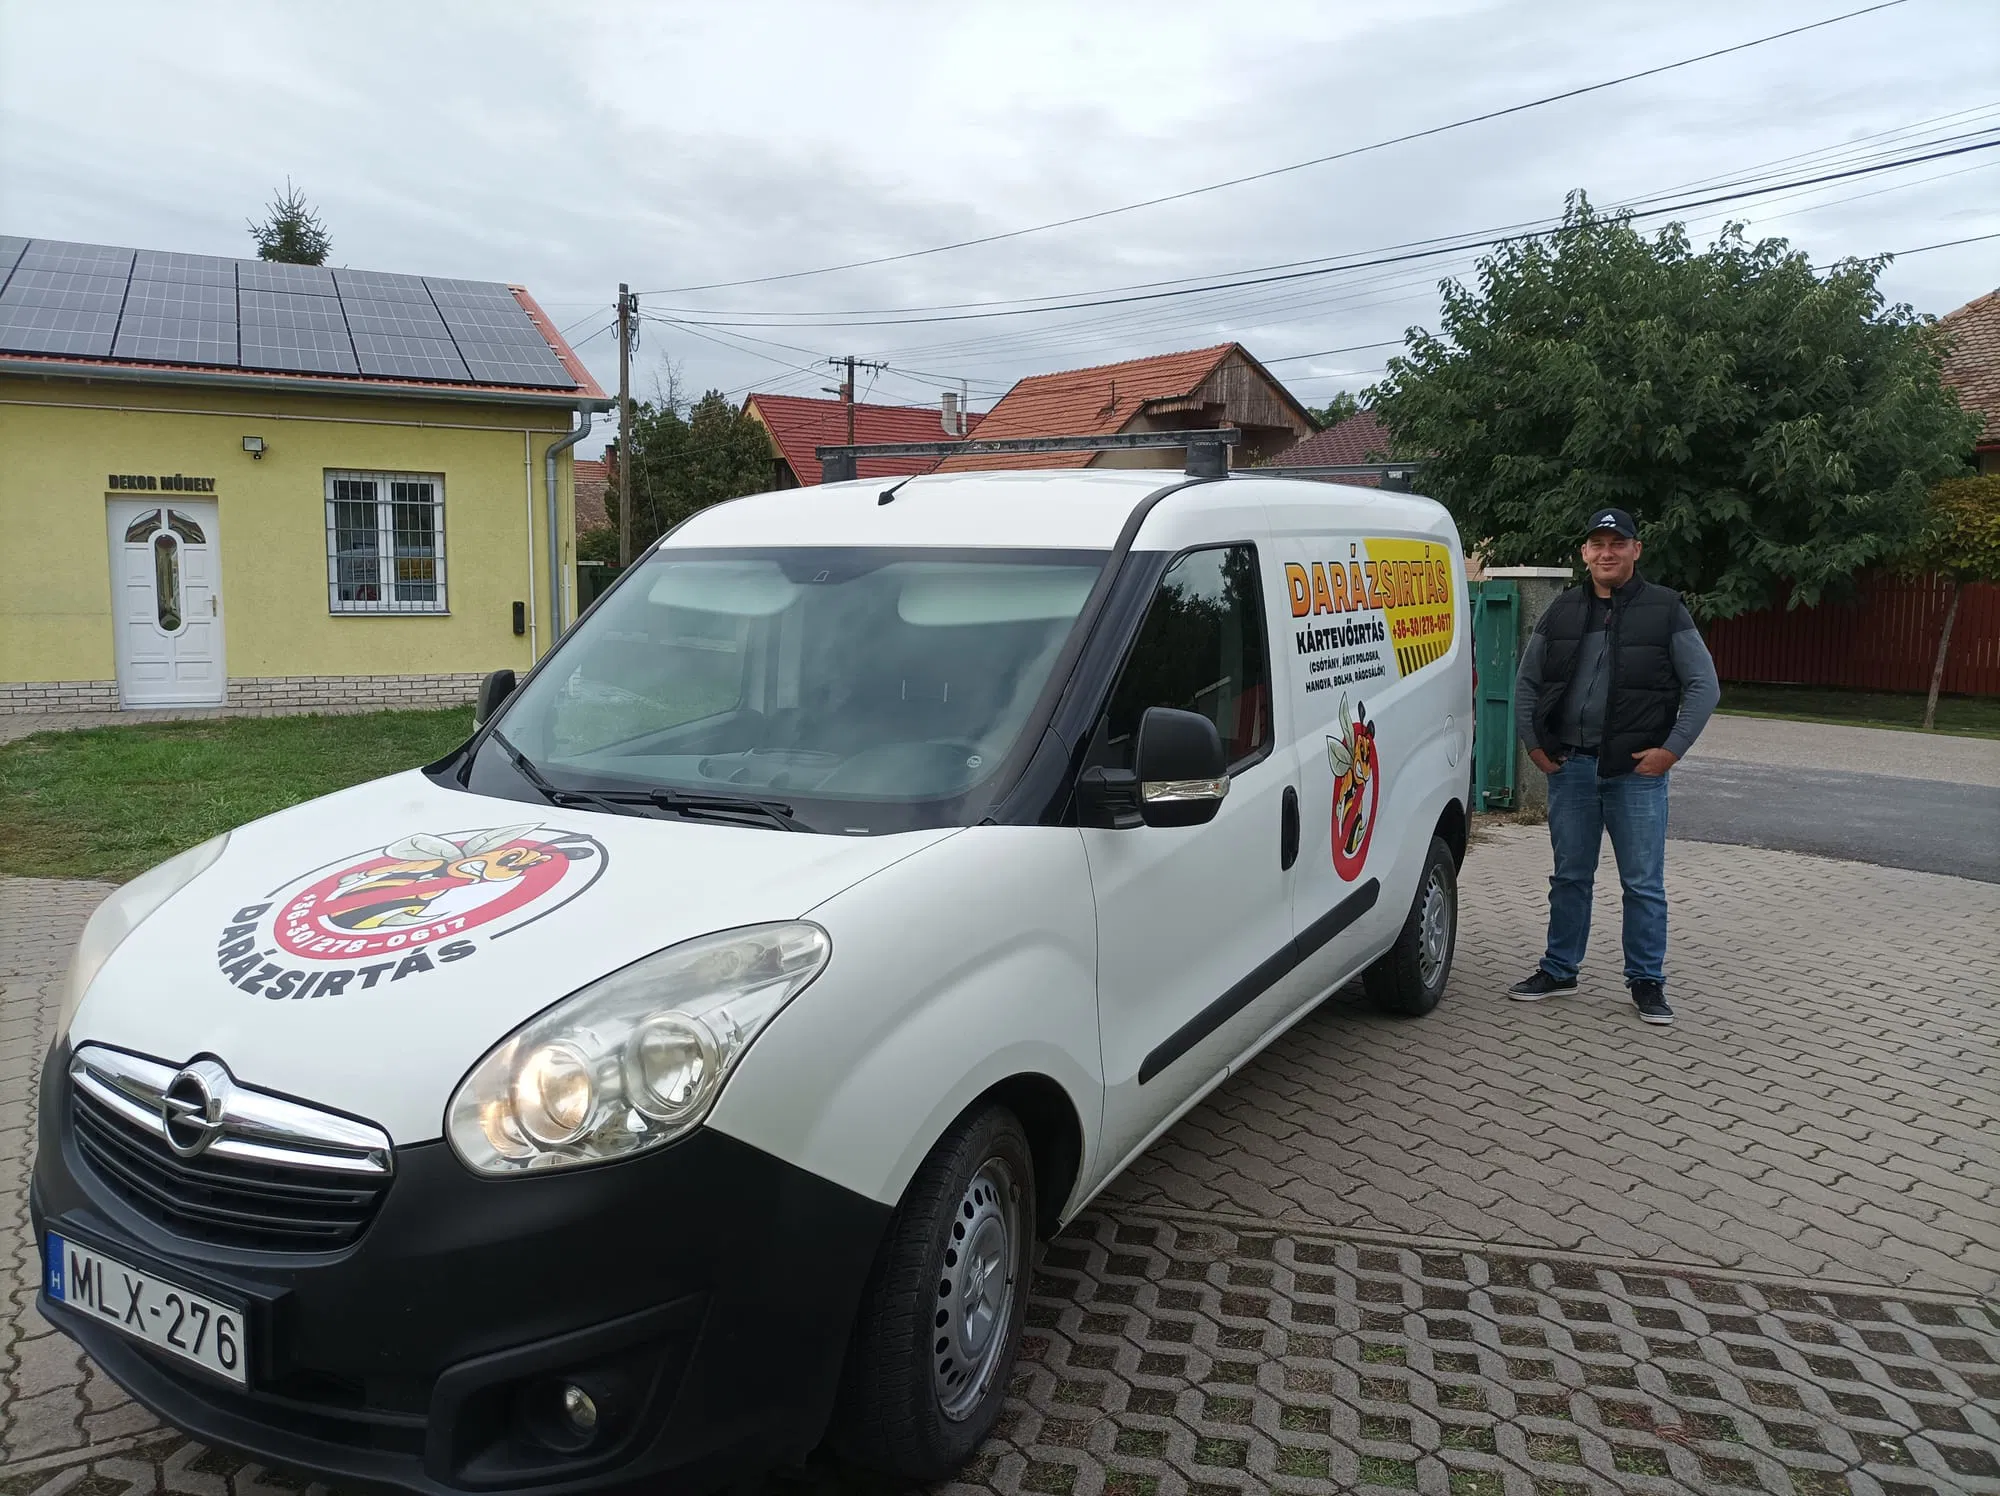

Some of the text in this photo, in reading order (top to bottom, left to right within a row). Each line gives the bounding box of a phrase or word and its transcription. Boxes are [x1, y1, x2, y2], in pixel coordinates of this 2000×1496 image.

[108, 473, 216, 492] DEKOR MŰHELY
[1284, 543, 1449, 618] DARÁZSIRTÁS
[1296, 616, 1385, 655] KÁRTEVŐIRTÁS
[1392, 613, 1451, 639] +36-30/278-0617
[1305, 677, 1333, 693] HANGYA,
[1333, 673, 1354, 687] BOLHA,
[1309, 655, 1342, 675] (CSÓTÁNY,
[286, 894, 467, 954] +36-30/278-0617
[217, 902, 477, 1000] DARÁZSIRTÁS
[51, 1249, 237, 1370] H MLX-276
